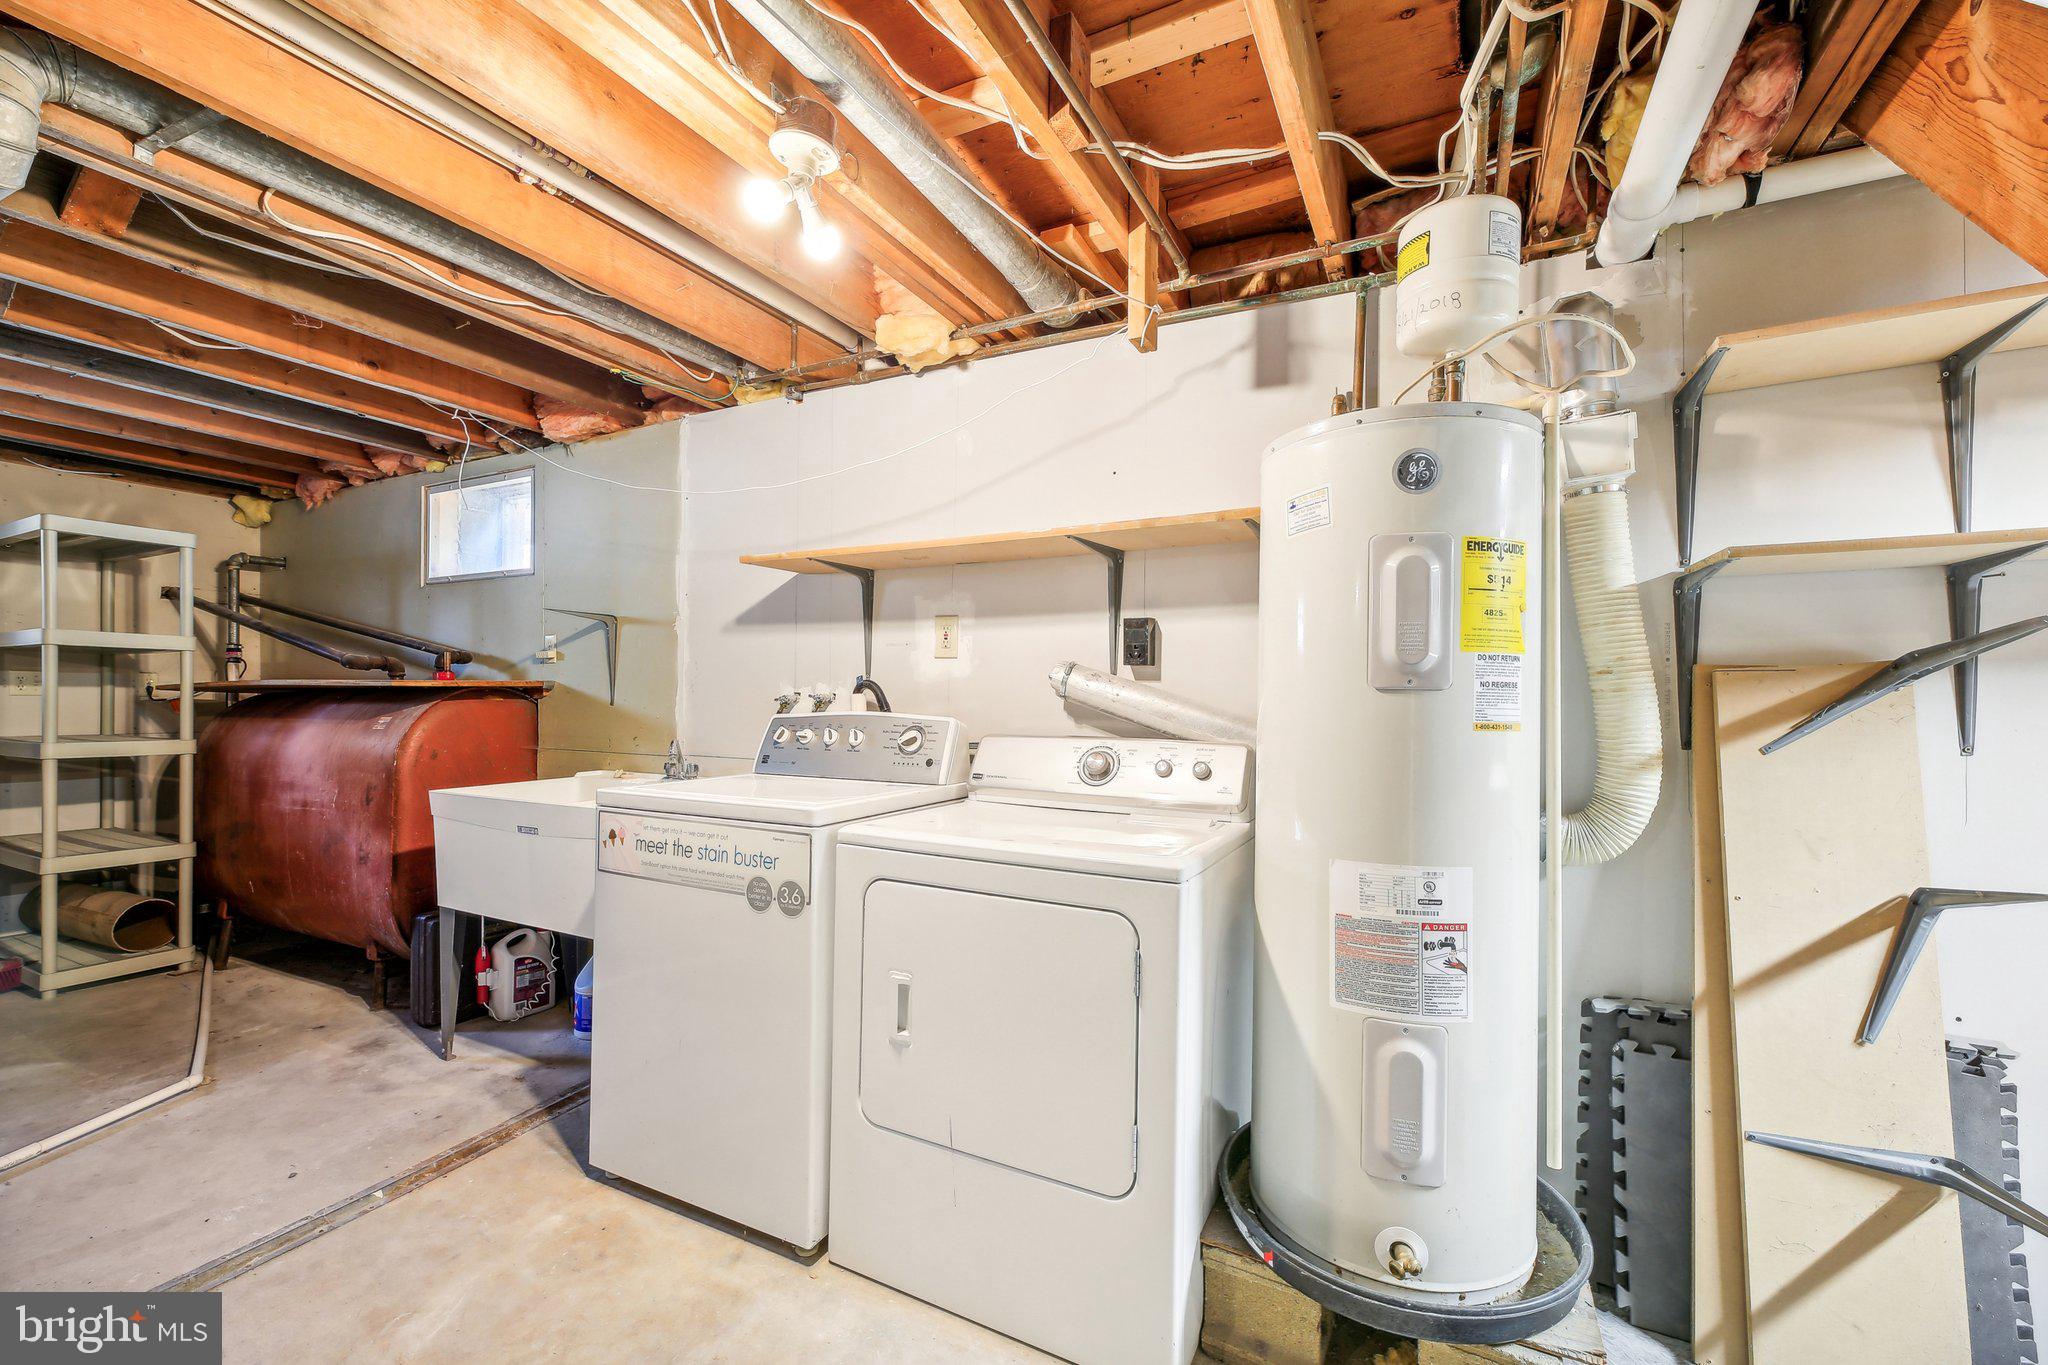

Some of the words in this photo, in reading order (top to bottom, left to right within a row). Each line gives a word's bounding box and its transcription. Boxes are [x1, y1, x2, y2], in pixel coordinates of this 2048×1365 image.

[1406, 459, 1430, 483] GE
[1466, 540, 1525, 556] ENERGYGUIDE
[1477, 653, 1487, 661] DO
[1500, 655, 1521, 663] RETURN
[1491, 681, 1518, 689] REGRESE
[635, 837, 669, 856] meet
[672, 837, 693, 859] the
[697, 843, 729, 864] stain
[733, 845, 779, 870] buster
[779, 886, 801, 906] 3.6
[1432, 923, 1466, 931] DANGER
